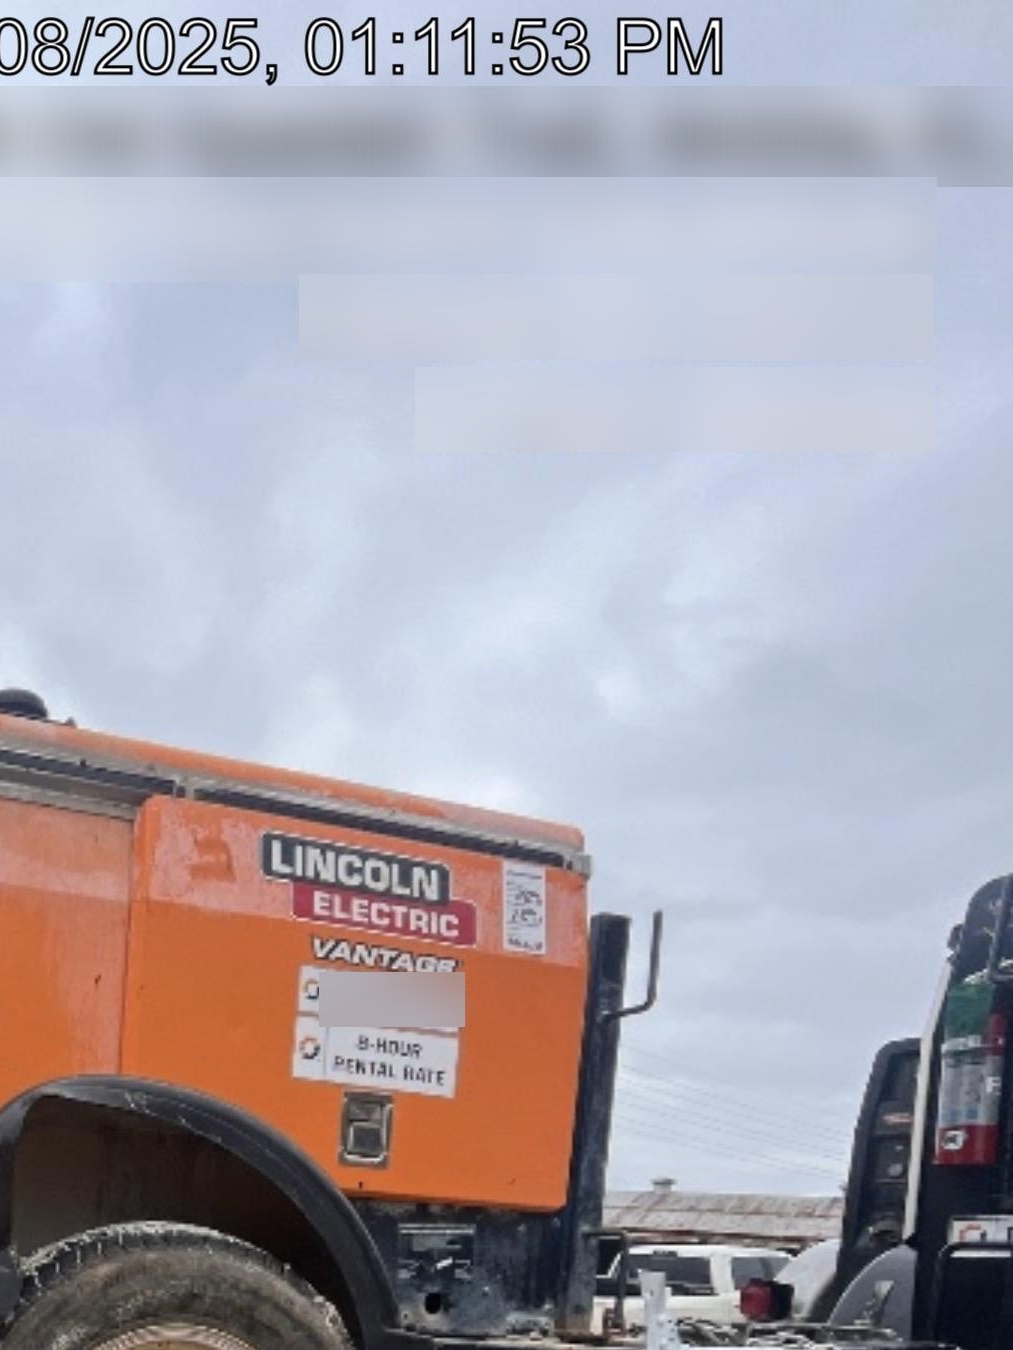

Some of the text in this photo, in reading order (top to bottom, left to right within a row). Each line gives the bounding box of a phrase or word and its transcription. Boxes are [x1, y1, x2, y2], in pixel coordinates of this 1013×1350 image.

[271, 838, 439, 902] LINCOLN
[313, 890, 460, 938] ELECTRIC
[333, 1055, 446, 1086] RENTAL RATE
